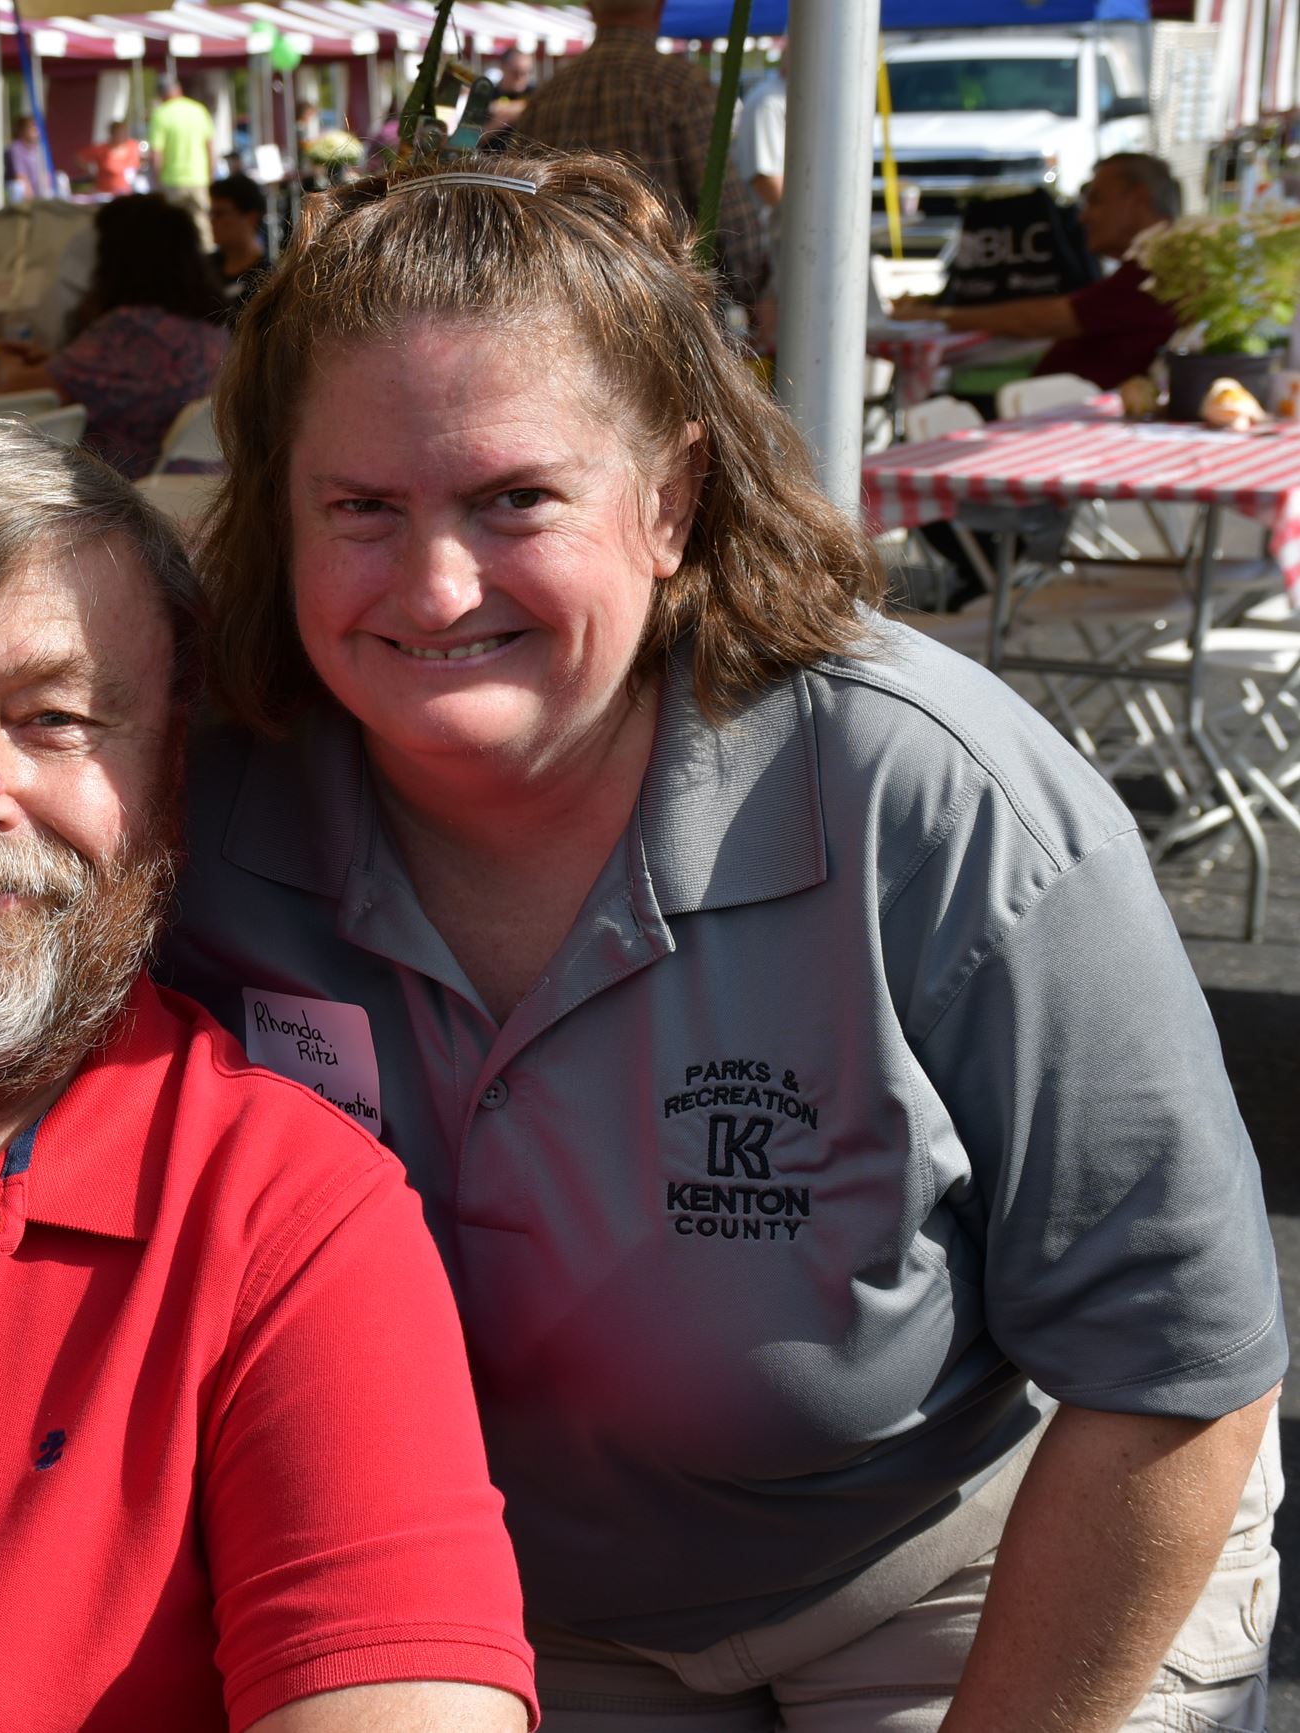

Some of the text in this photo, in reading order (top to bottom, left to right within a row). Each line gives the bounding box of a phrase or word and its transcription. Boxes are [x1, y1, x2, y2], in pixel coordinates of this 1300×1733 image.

[254, 1001, 326, 1043] Rhonda
[296, 1040, 339, 1066] Ritzi
[685, 1059, 799, 1094] PARKS &
[314, 1083, 378, 1121] reation
[664, 1086, 818, 1130] RECREATION
[667, 1182, 810, 1217] KENTON
[675, 1216, 802, 1241] COUNTY
